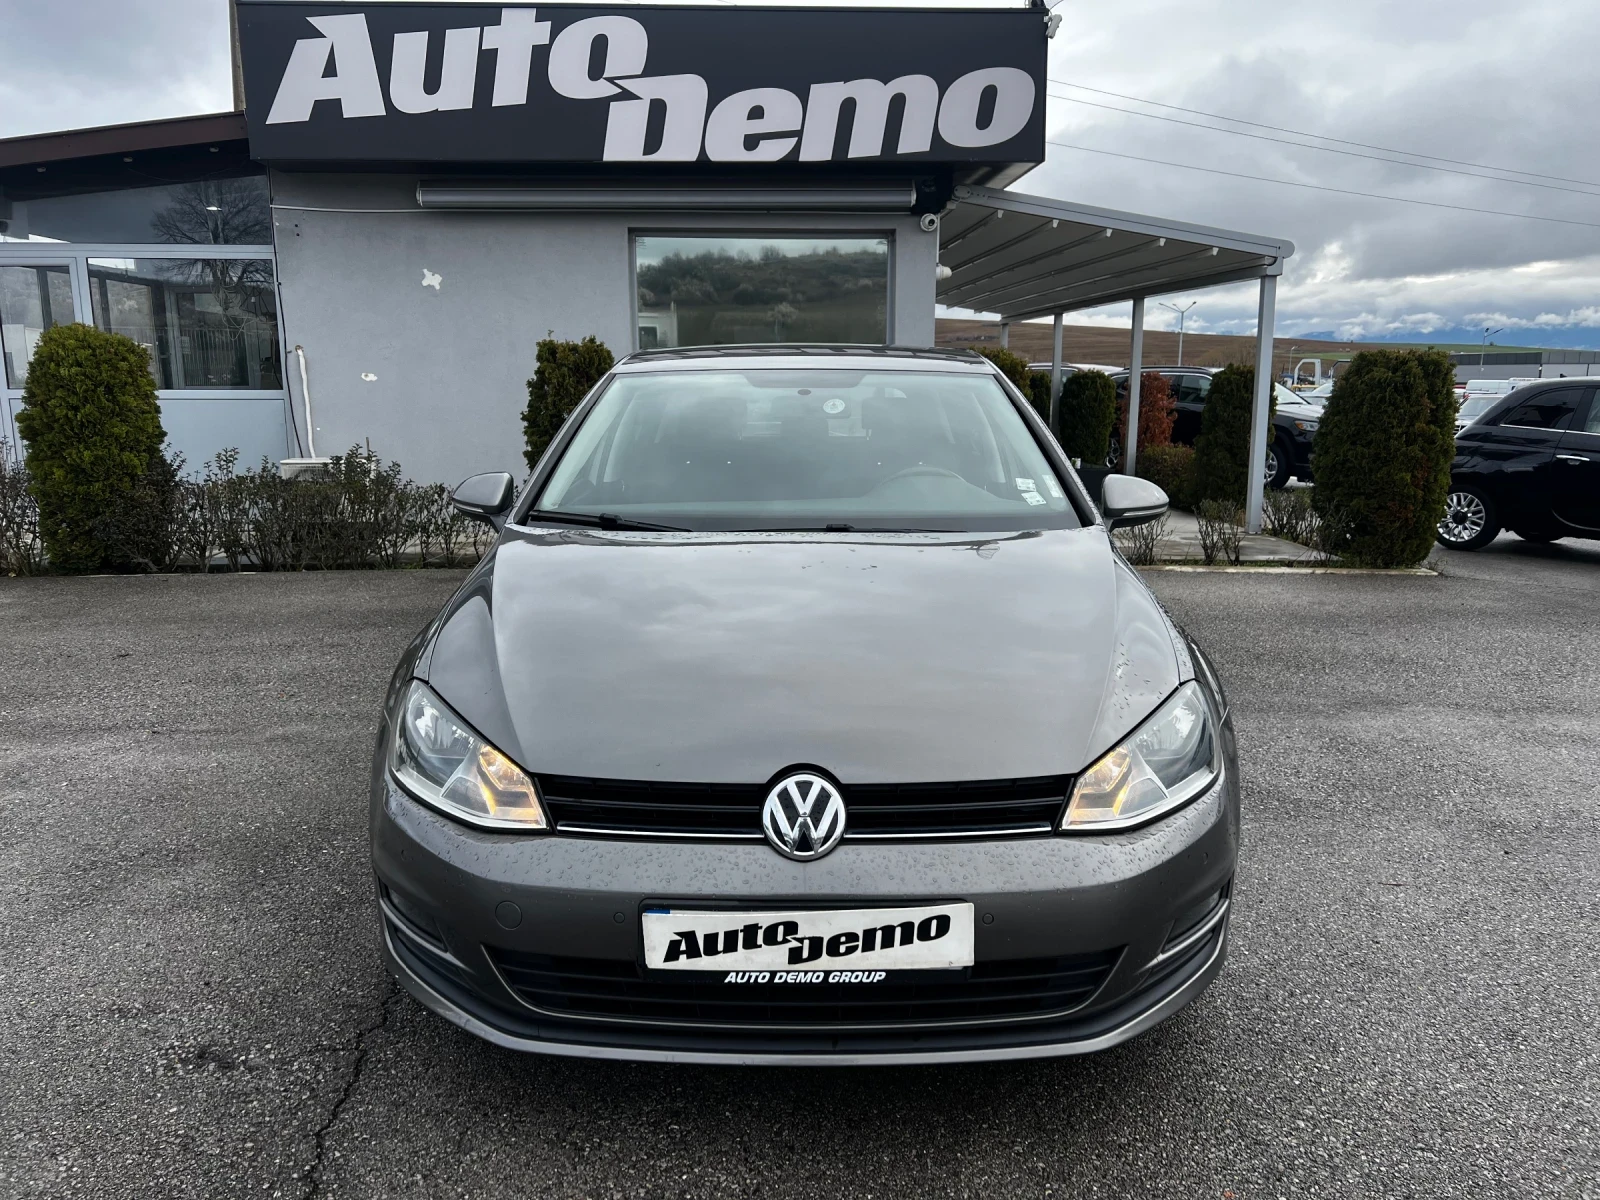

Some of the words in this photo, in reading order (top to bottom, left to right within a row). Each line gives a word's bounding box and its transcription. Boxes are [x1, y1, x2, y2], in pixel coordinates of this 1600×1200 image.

[724, 971, 771, 984] AUTO
[773, 971, 825, 984] DEMO
[828, 971, 887, 984] GROUP
